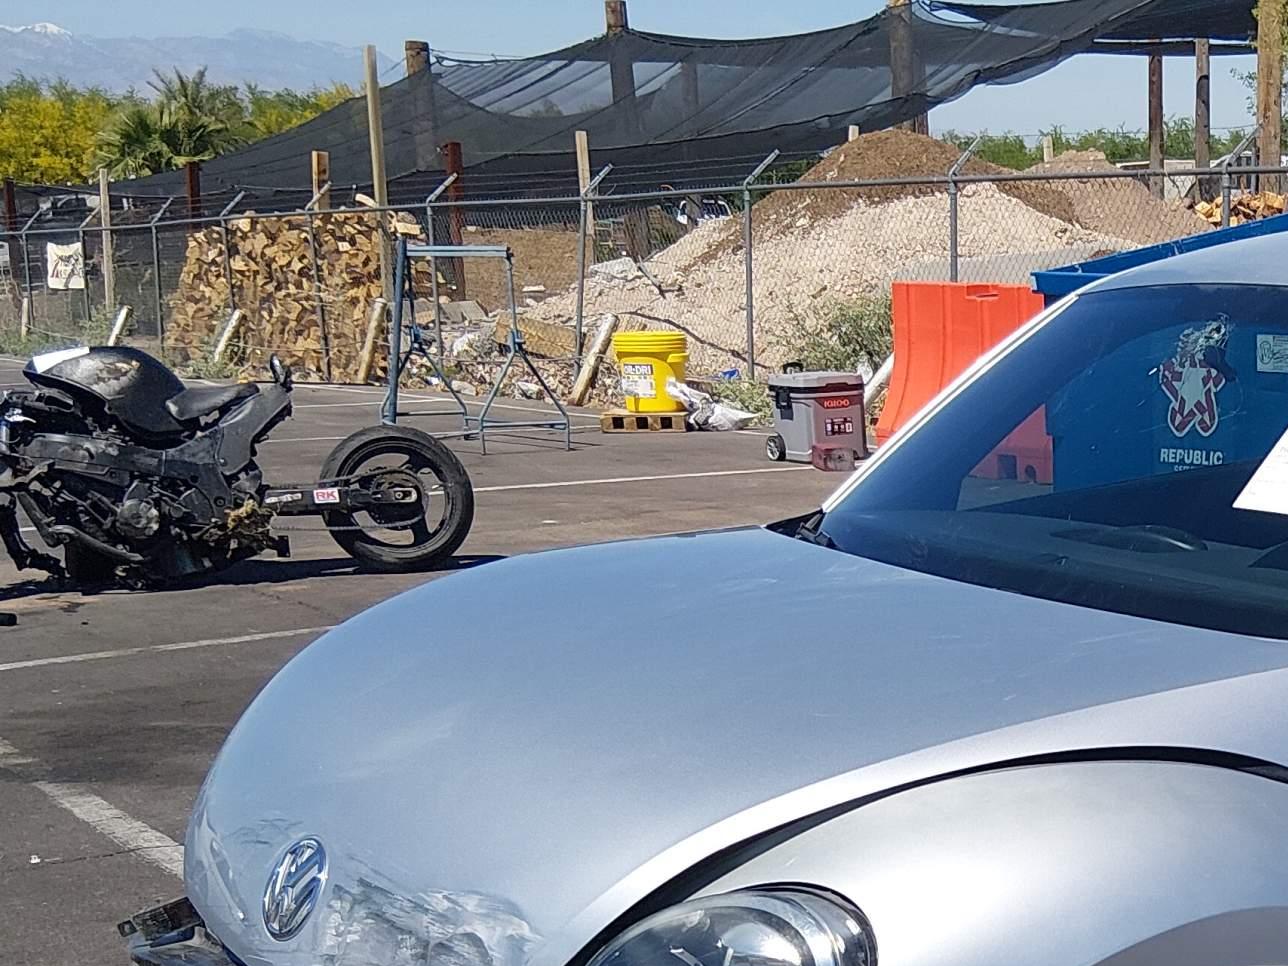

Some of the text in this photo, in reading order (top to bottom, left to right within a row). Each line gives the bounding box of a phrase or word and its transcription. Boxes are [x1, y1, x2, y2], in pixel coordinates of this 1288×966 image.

[823, 398, 850, 408] IGLOO
[1159, 448, 1224, 466] REPUBLIC
[315, 490, 337, 502] RK
